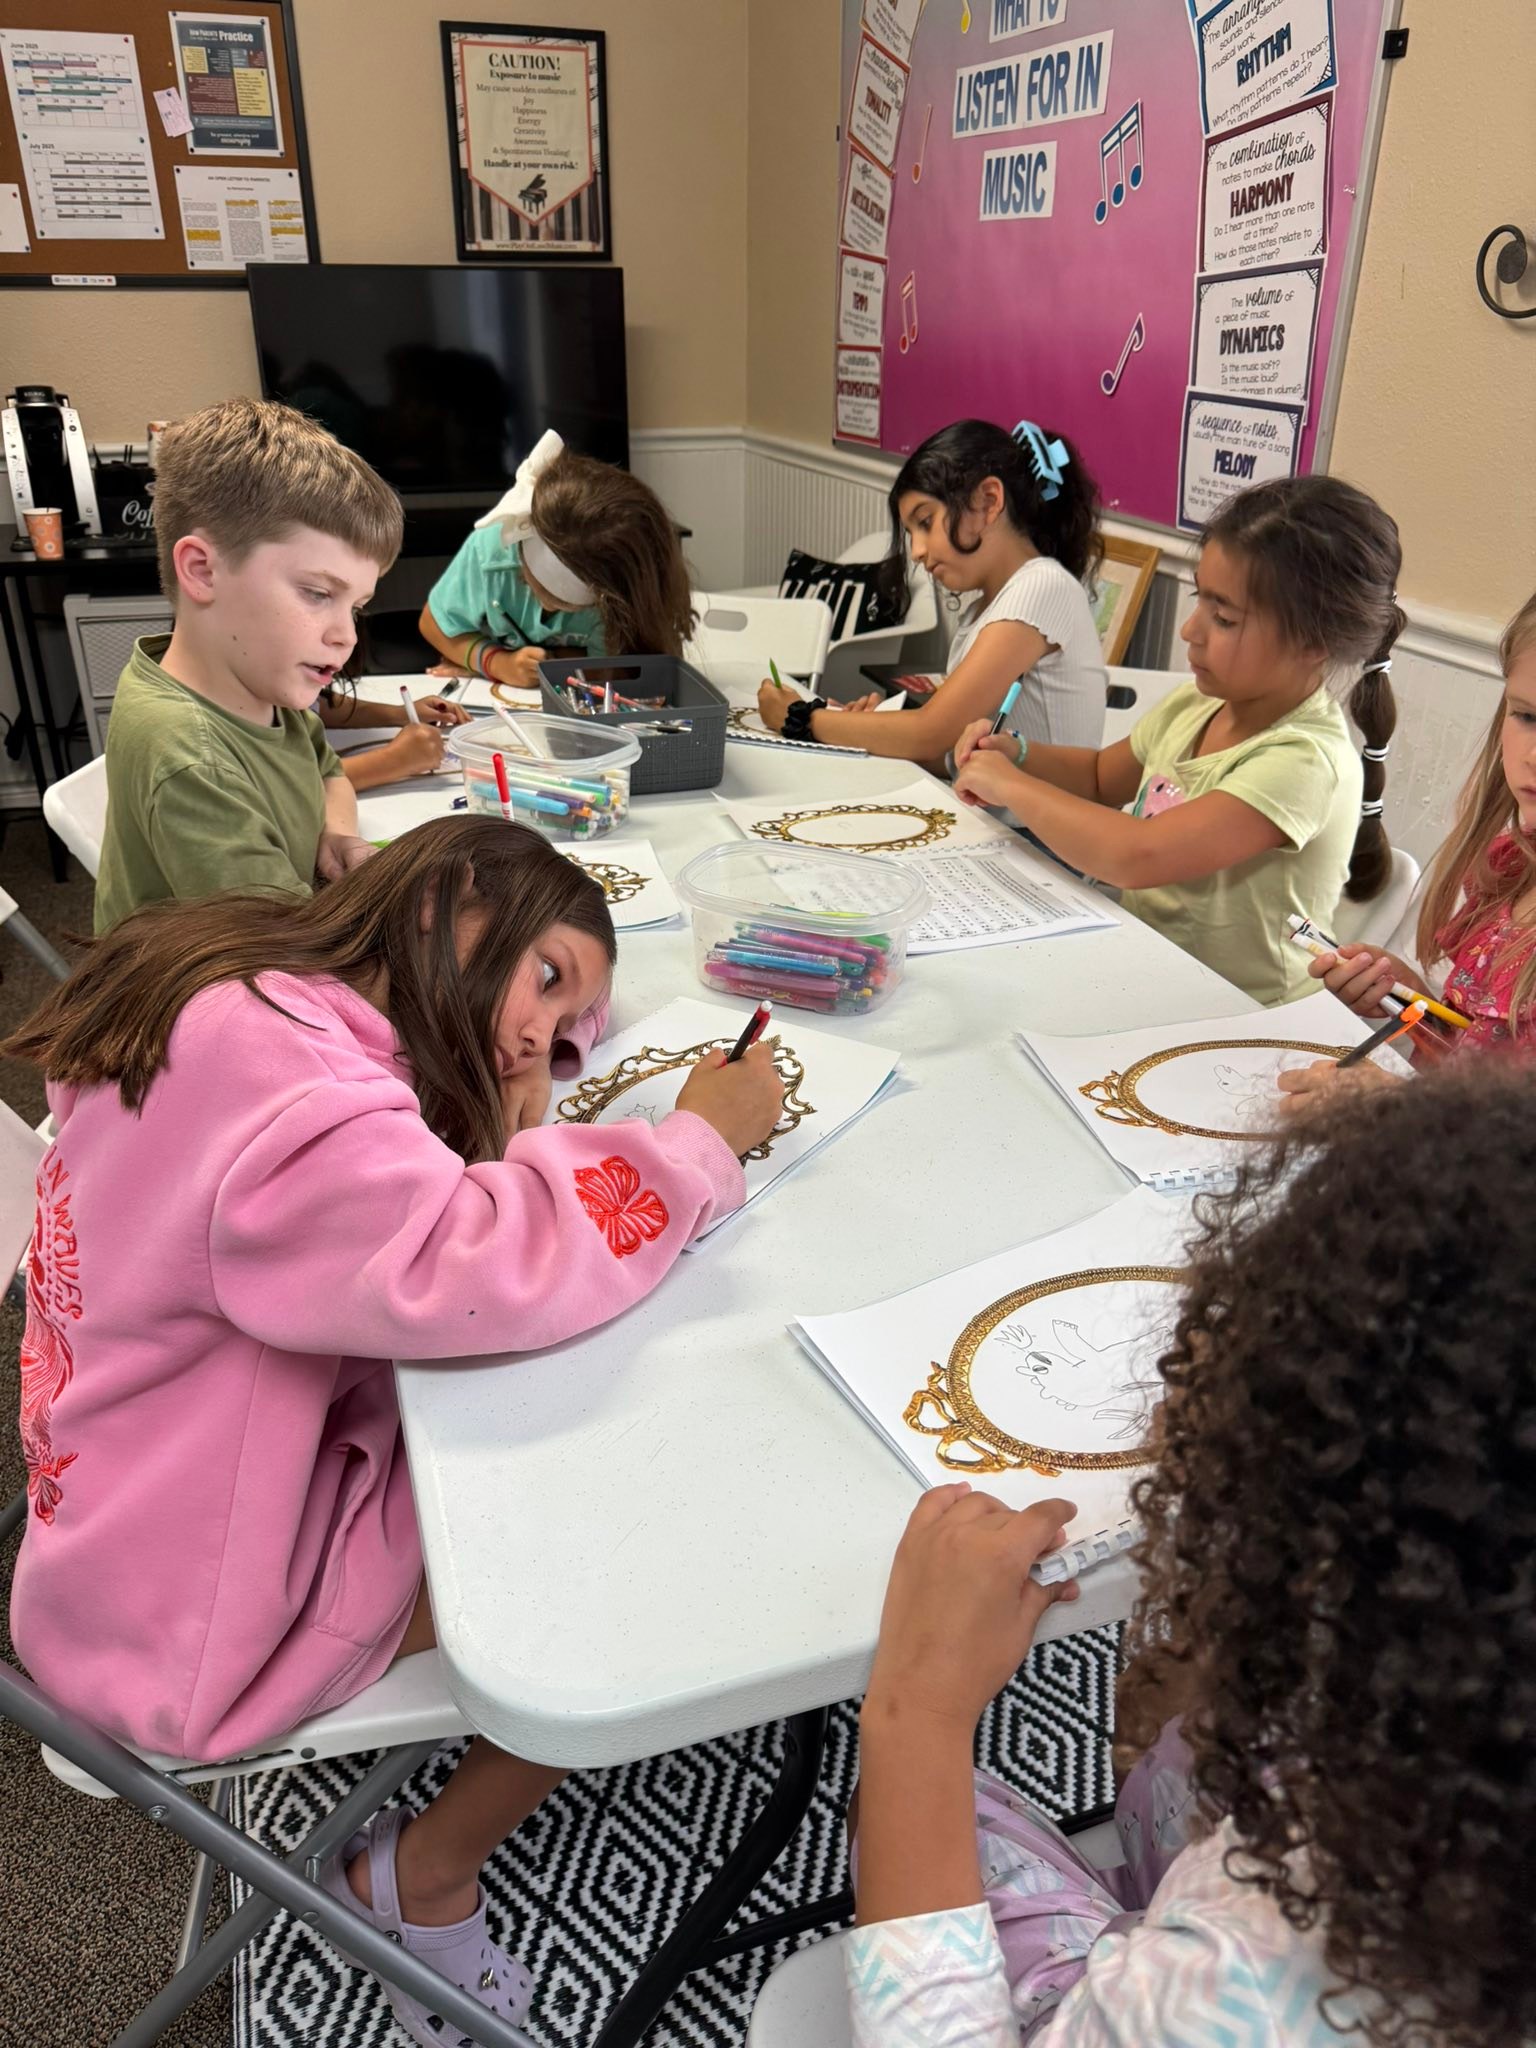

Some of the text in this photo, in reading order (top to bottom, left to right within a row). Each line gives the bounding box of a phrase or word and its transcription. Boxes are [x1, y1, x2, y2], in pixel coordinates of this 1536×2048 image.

[219, 30, 254, 43] Practice
[1207, 30, 1221, 45] The
[1219, 26, 1244, 51] sounds
[1244, 15, 1259, 31] and
[488, 52, 561, 71] CAUTION!
[1211, 31, 1257, 73] musical work
[1236, 22, 1293, 88] RHYTHM
[490, 69, 561, 81] Exposure to music
[1212, 35, 1330, 128] What rhythm patterns do I hear?
[476, 83, 491, 93] May
[492, 85, 511, 93] cause
[512, 84, 537, 94] sudden
[568, 87, 577, 96] of
[955, 63, 1020, 133] LISTEN
[1027, 51, 1071, 121] FOR
[1074, 42, 1104, 112] IN
[1237, 107, 1250, 122] any
[1249, 86, 1282, 115] patterns
[1282, 61, 1313, 90] repeat?
[512, 105, 548, 117] Happiness
[522, 96, 535, 106] Joy
[517, 116, 541, 127] Energy
[513, 127, 546, 137] Creativity
[513, 137, 548, 146] Awareness
[29, 143, 41, 151] July
[500, 146, 542, 156] Spontaneous
[1216, 131, 1306, 172] The combination of
[483, 159, 512, 168] Handle
[513, 160, 521, 169] at
[522, 161, 541, 171] your
[1221, 140, 1317, 186] notes to make chords
[983, 151, 1048, 215] MUSIC
[1230, 171, 1295, 219] HARMONY
[1213, 226, 1223, 238] Do
[1229, 221, 1244, 232] hear
[1245, 215, 1263, 227] more
[1264, 210, 1281, 221] than
[1281, 206, 1296, 217] one
[1297, 201, 1316, 213] note
[1243, 230, 1252, 241] at
[1259, 221, 1279, 236] time?
[1214, 228, 1313, 262] How do those notes relate to
[1239, 247, 1281, 267] each other?
[1231, 286, 1295, 308] The volume of
[1214, 309, 1270, 325] a piece of music
[1219, 323, 1286, 356] DYNAMICS
[1221, 359, 1281, 373] Is the music soft?
[1221, 372, 1279, 385] Is the music loud?
[1266, 386, 1274, 396] in
[1274, 383, 1302, 396] volume?
[1201, 414, 1242, 434] sequence
[1243, 424, 1252, 434] of
[1193, 431, 1213, 444] usually
[1226, 436, 1242, 446] main
[1242, 438, 1257, 449] tune
[1258, 440, 1268, 450] of
[1274, 443, 1291, 457] song
[1213, 448, 1257, 480] MELODY
[121, 499, 156, 529] Cof
[53, 1193, 84, 1320] WAVES
